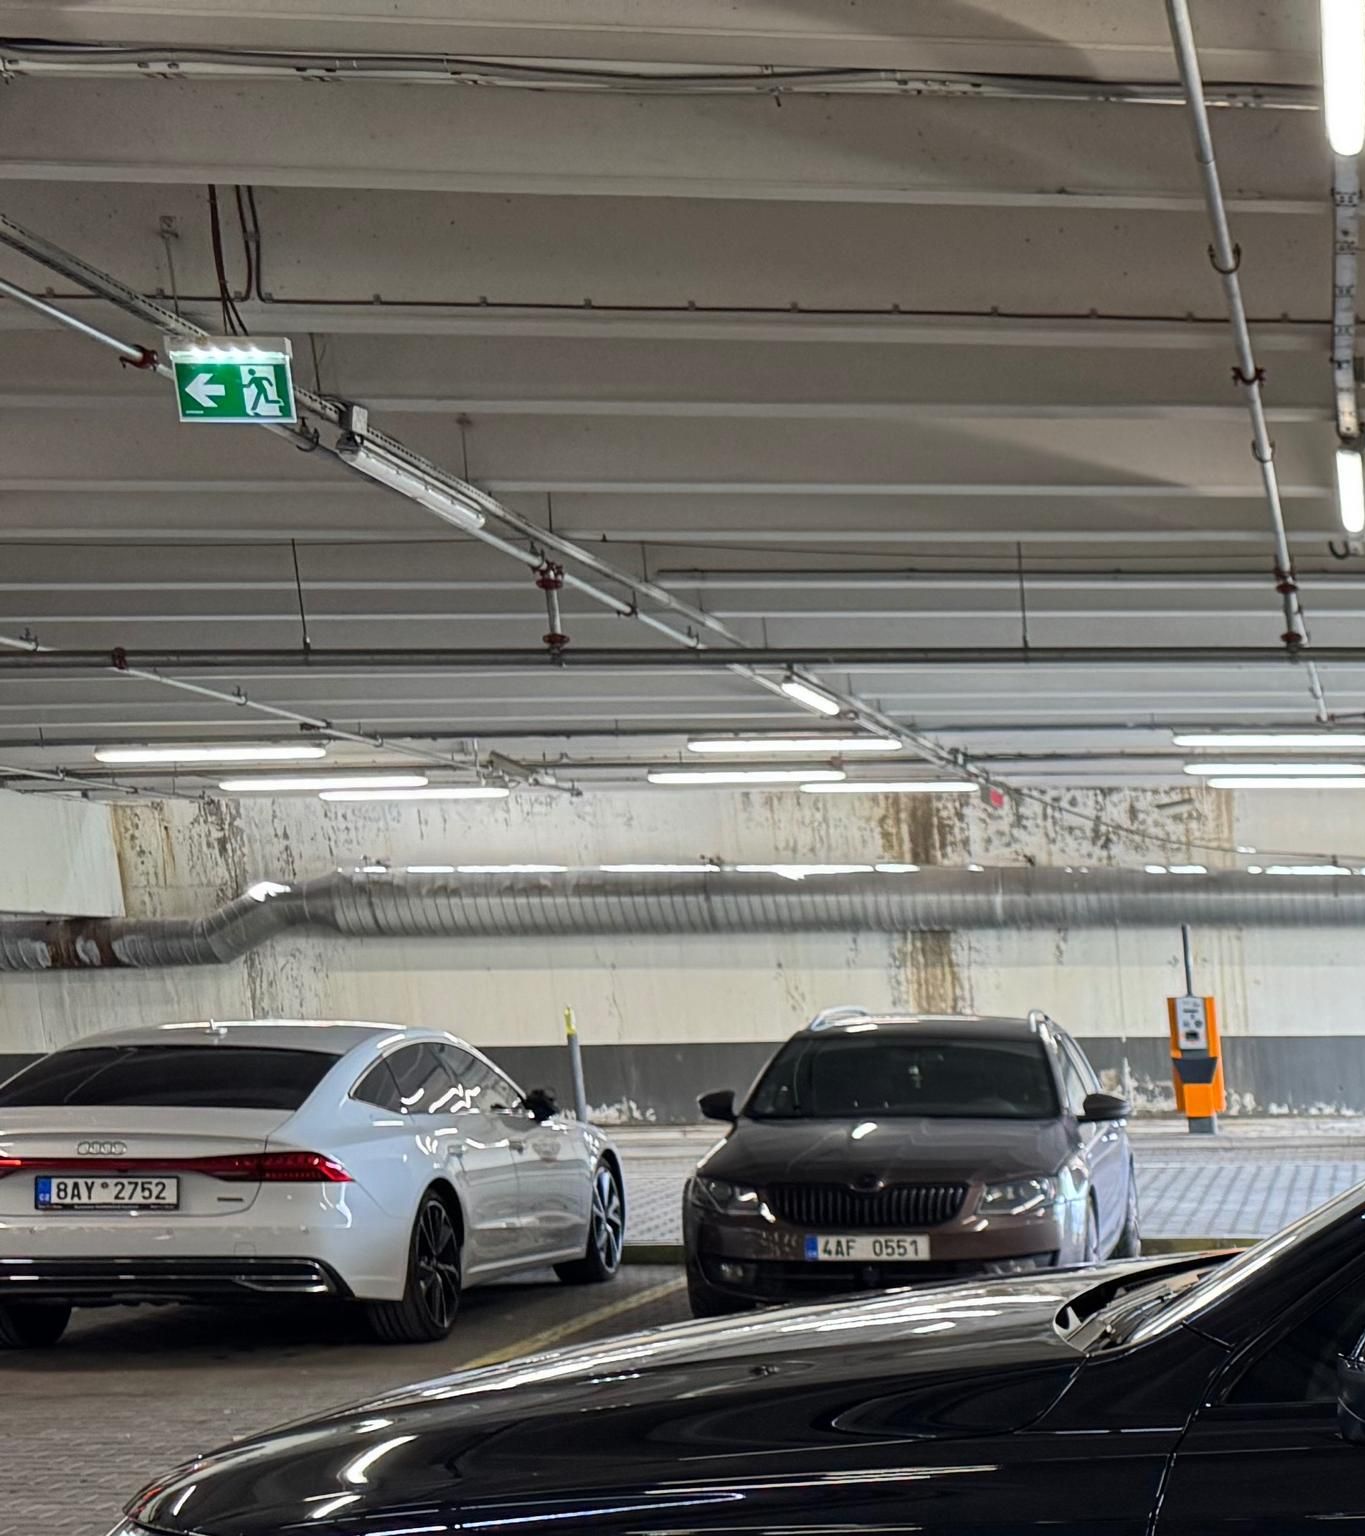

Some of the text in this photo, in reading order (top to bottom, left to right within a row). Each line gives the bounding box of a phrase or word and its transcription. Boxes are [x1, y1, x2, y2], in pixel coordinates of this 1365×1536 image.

[56, 1180, 167, 1201] 8AY 2752
[822, 1239, 919, 1257] 4AF 0551
